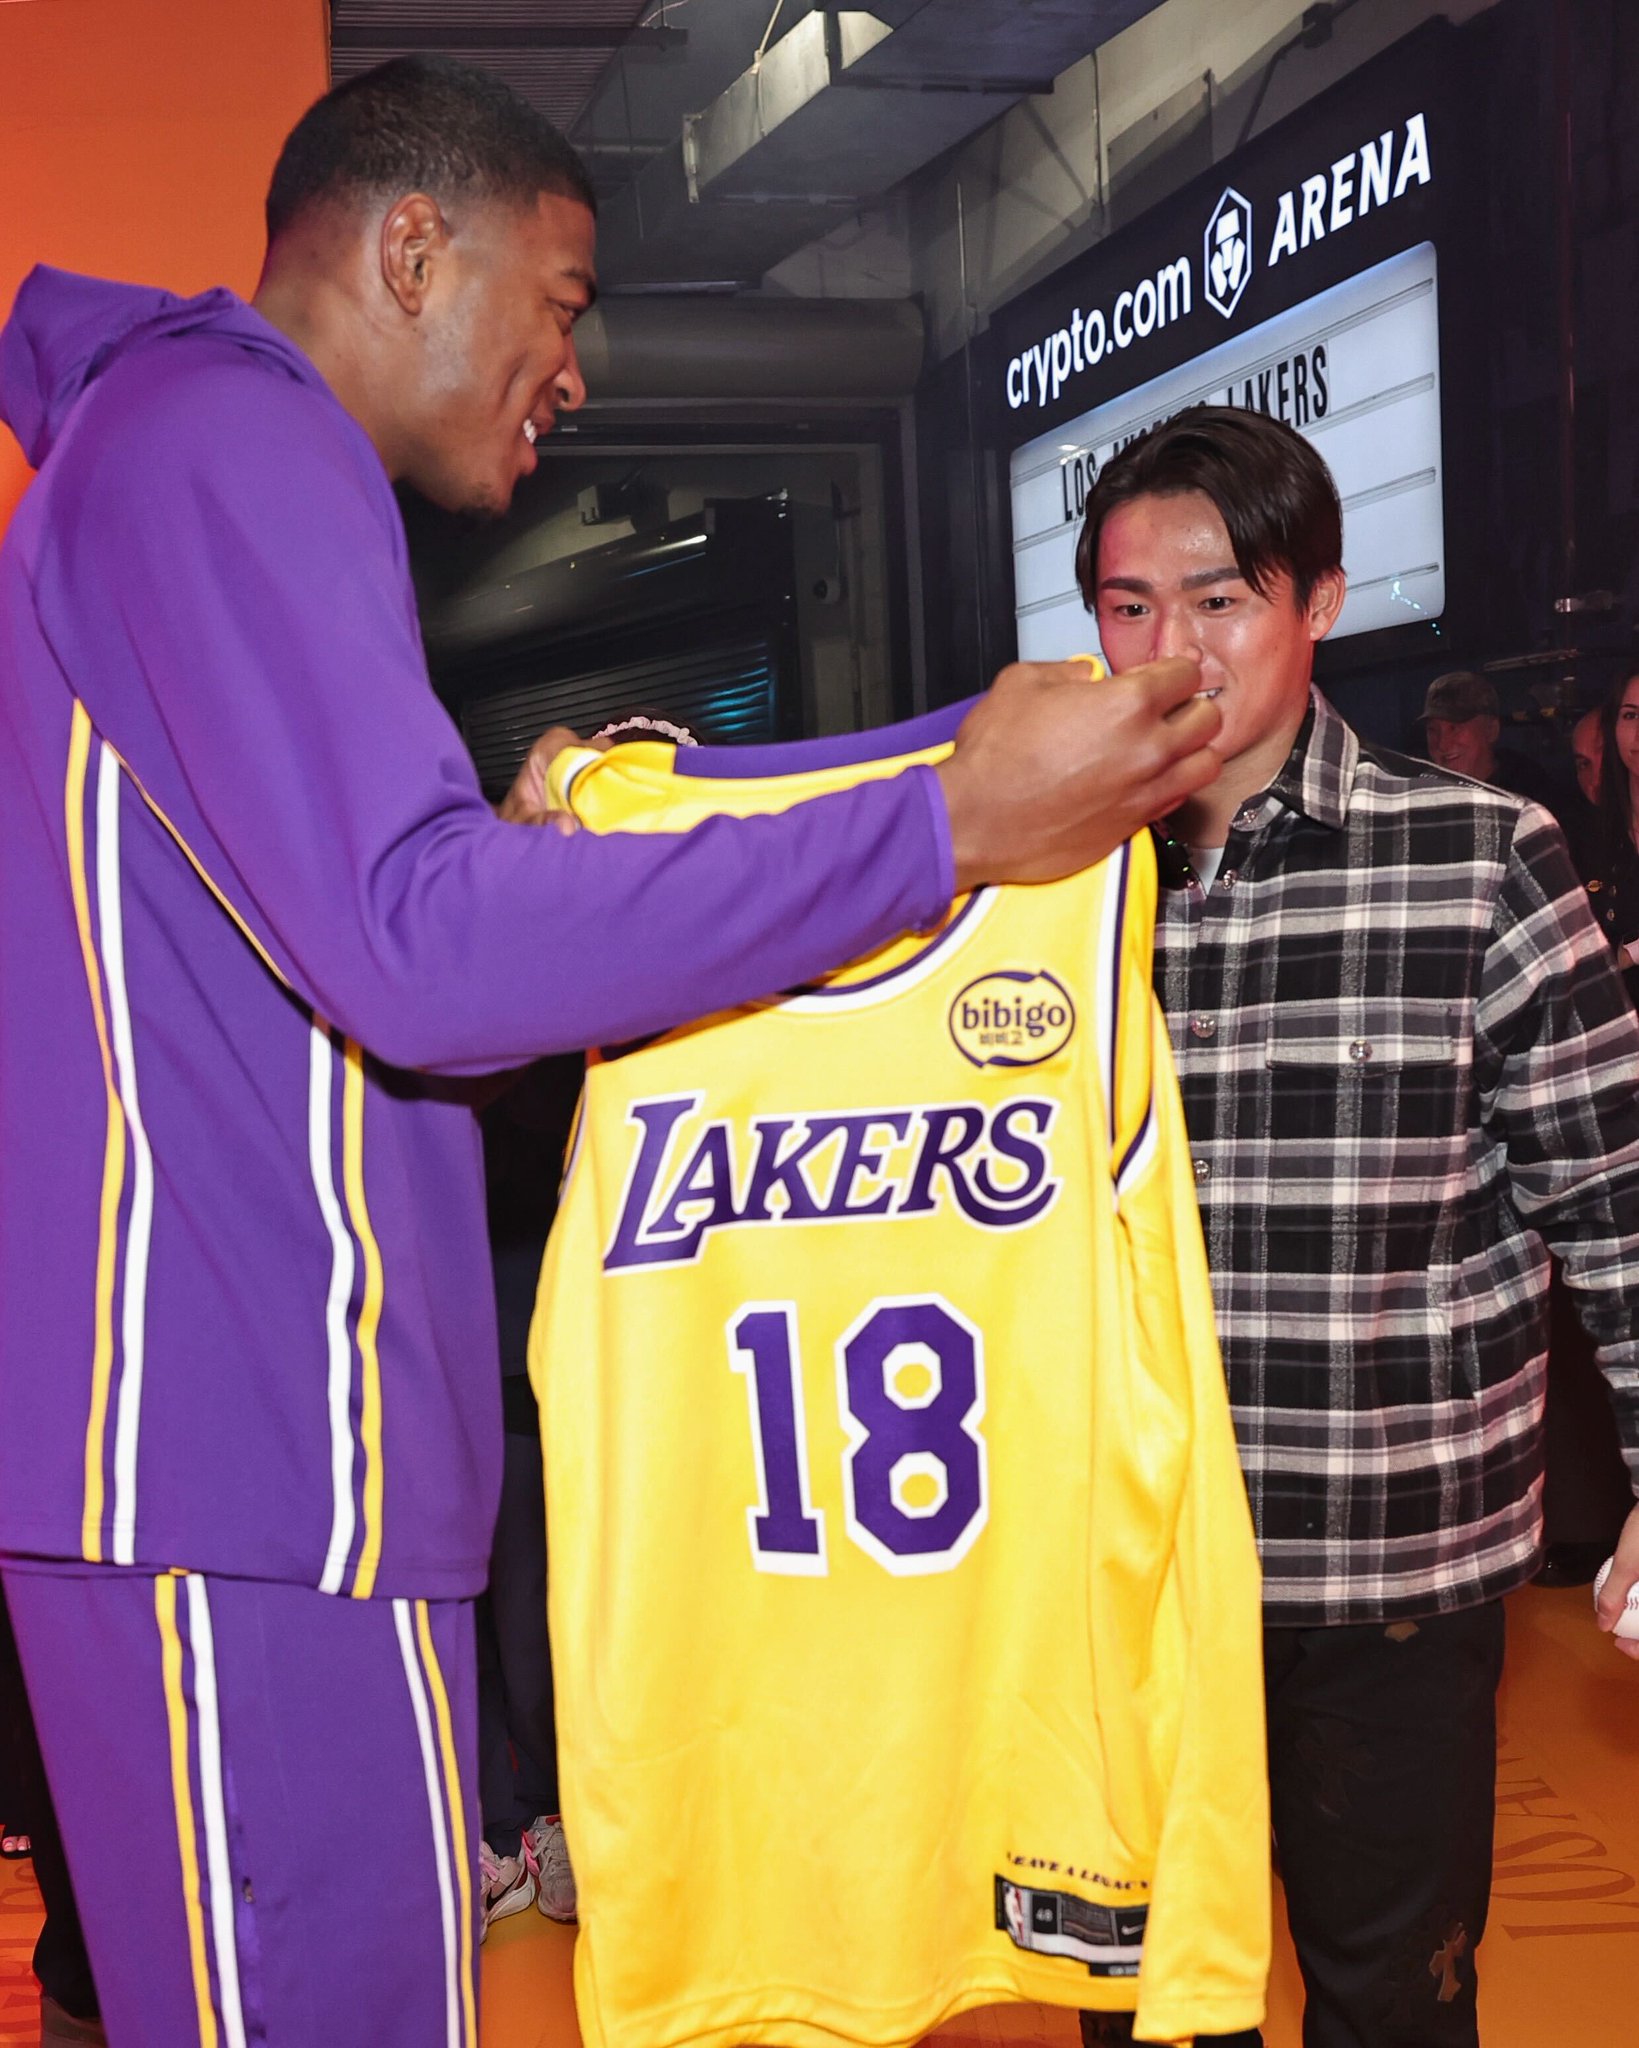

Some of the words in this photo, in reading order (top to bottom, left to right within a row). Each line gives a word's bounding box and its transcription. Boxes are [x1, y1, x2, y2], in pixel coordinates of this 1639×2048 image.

[1006, 256, 1191, 408] crypto.com
[1267, 112, 1432, 267] ARENA
[1228, 345, 1328, 427] KERS
[962, 997, 1066, 1038] bibigo
[603, 1089, 1063, 1277] LAKERS
[726, 1293, 988, 1577] 18
